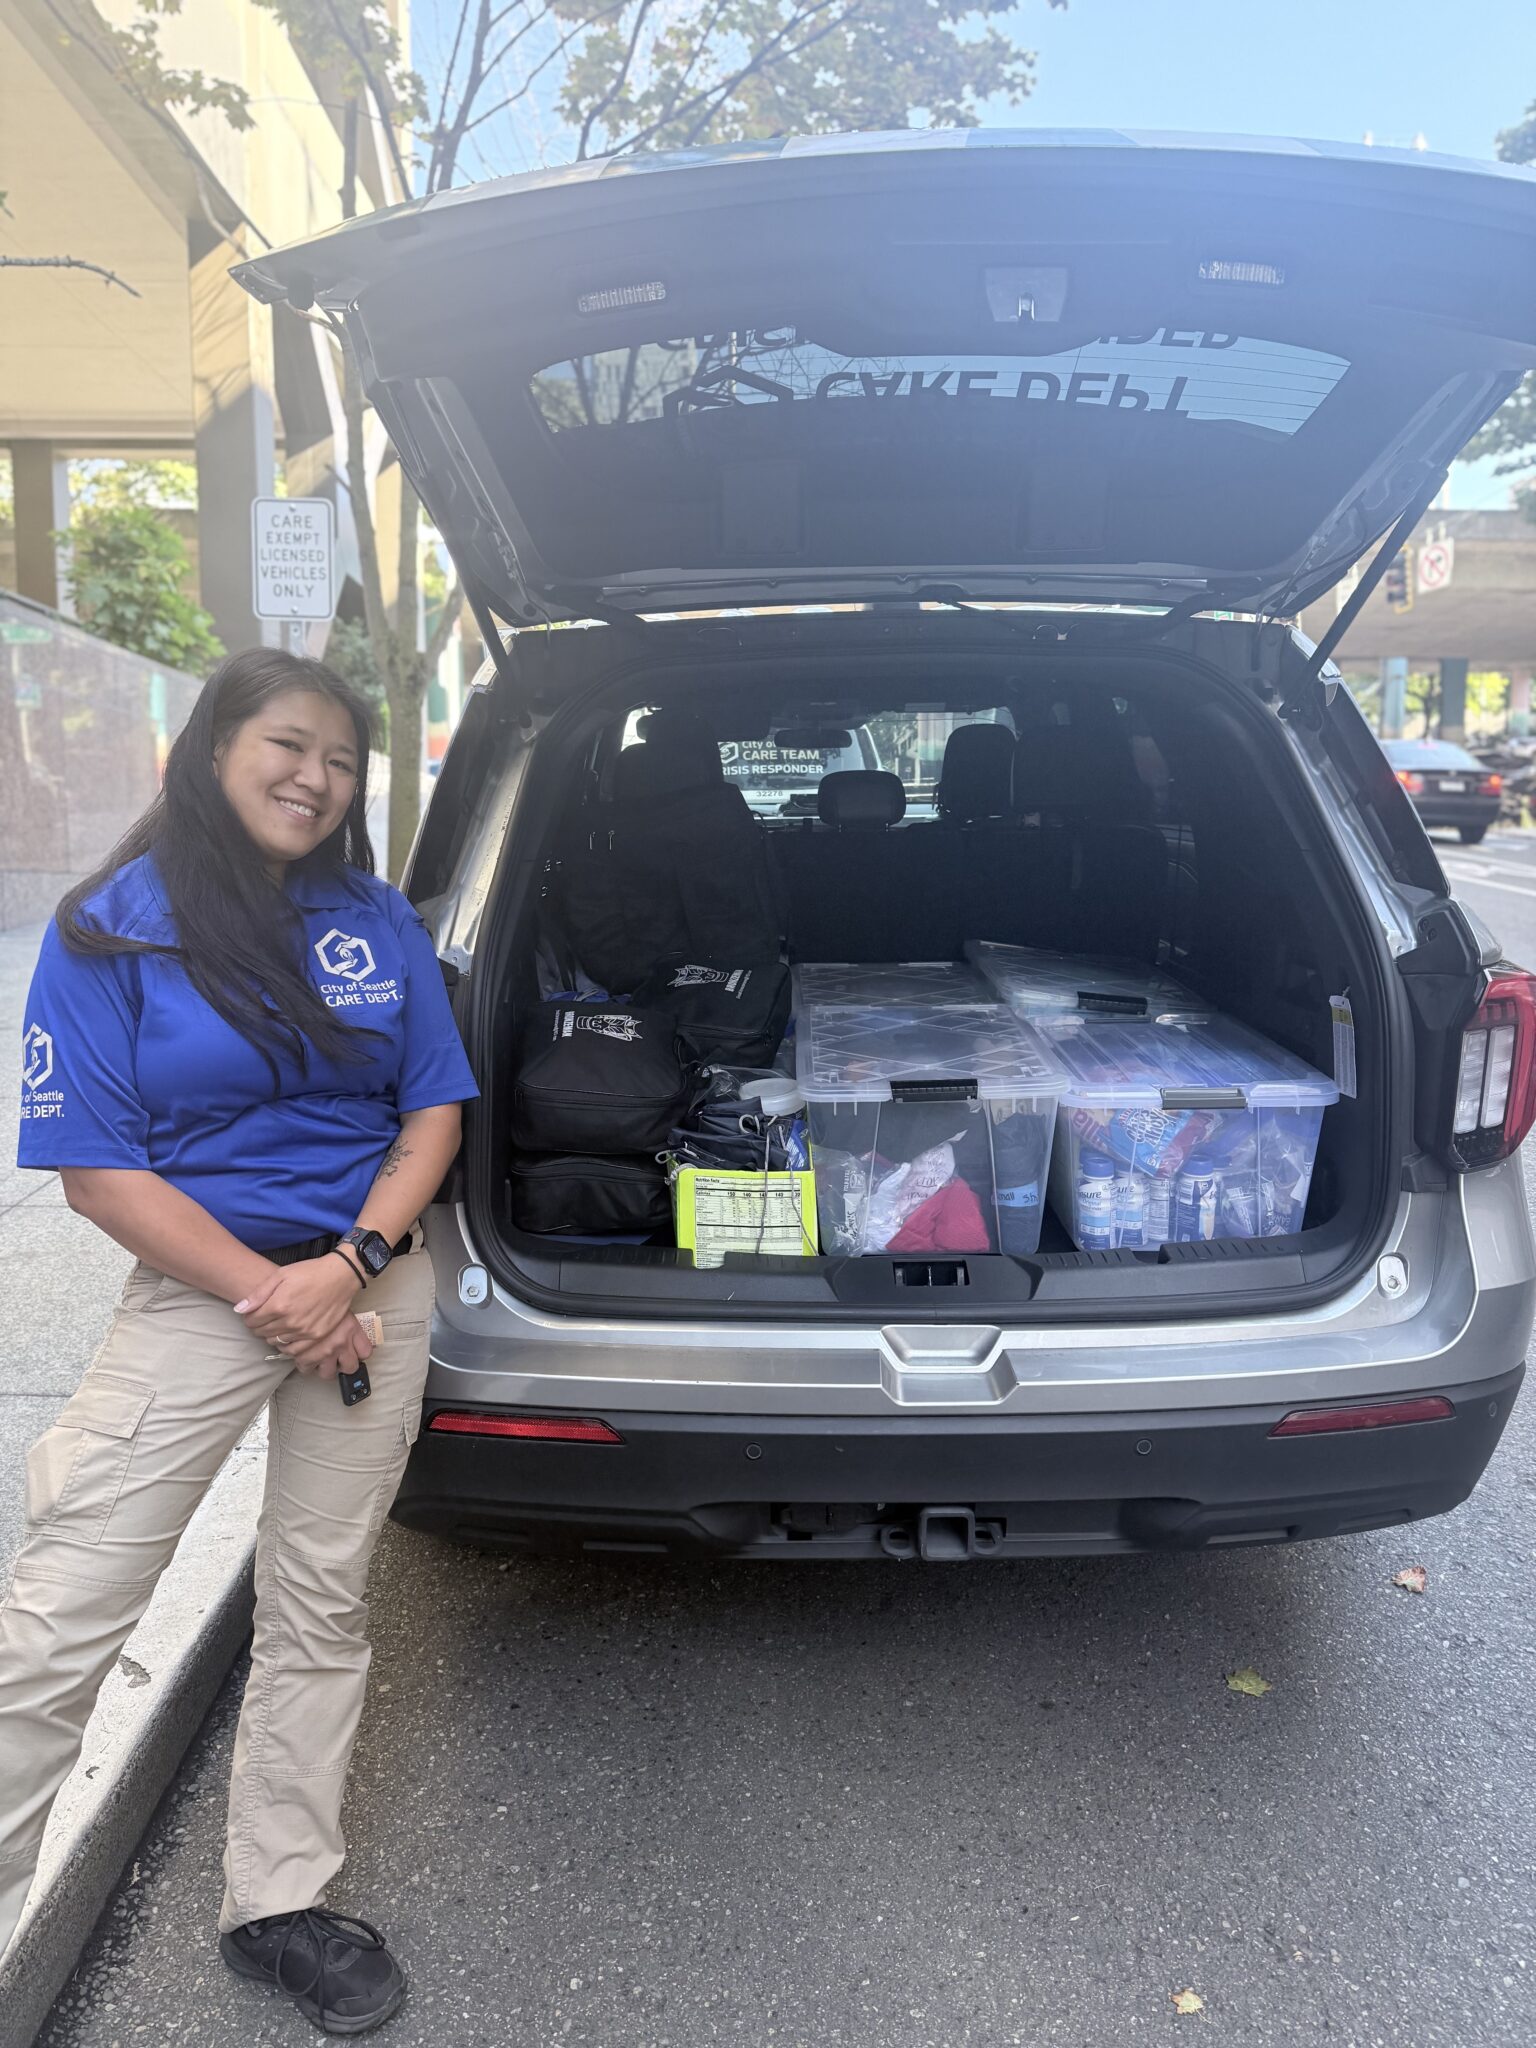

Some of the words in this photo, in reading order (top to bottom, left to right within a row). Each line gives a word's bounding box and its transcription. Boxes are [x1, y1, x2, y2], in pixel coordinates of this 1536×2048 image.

[270, 514, 313, 529] CARE
[266, 531, 321, 545] EXEMPT
[260, 548, 326, 563] LICENSED
[260, 565, 327, 580] VEHICLES
[272, 583, 315, 598] ONLY
[741, 741, 764, 750] City
[742, 750, 778, 760] CARE
[780, 750, 820, 760] TEAM
[722, 765, 750, 776] RISIS
[752, 764, 824, 774] RESPONDER
[320, 984, 344, 994] City
[346, 982, 358, 992] of
[359, 979, 397, 991] Seattle
[325, 993, 364, 1008] CARE
[365, 989, 403, 1004] DEPT.
[32, 1090, 64, 1102] Seattle
[20, 1106, 31, 1119] RE
[33, 1104, 65, 1118] DEPT.
